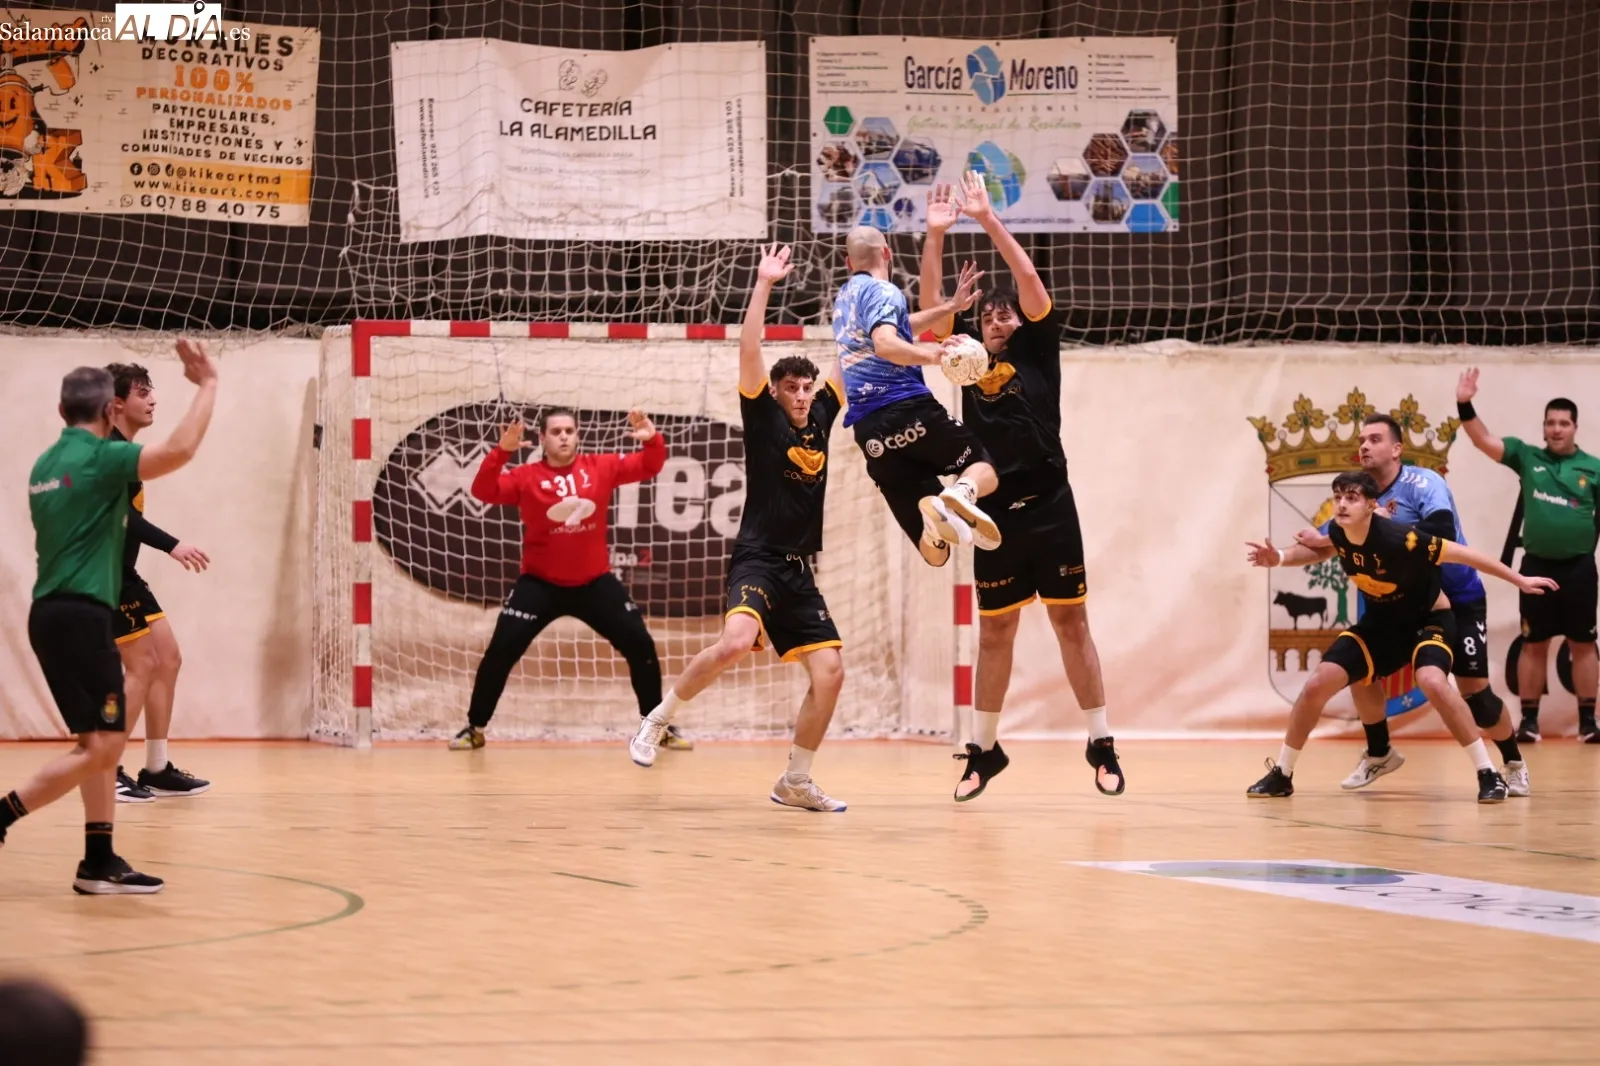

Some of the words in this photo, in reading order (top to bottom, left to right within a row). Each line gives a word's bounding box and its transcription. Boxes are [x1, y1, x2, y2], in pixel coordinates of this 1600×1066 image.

[142, 47, 284, 72] DECORATIVOS
[174, 64, 254, 94] 100%
[904, 55, 963, 90] García
[1008, 58, 1079, 91] Moreno
[136, 86, 293, 111] PERSONALIZADOS
[520, 95, 632, 117] CAFETERÍA
[152, 103, 276, 126] PARTICULARES,
[169, 118, 256, 138] EMPRESAS,
[499, 120, 523, 137] LA
[530, 123, 657, 142] ALAMEDILLA
[142, 129, 264, 150] INSTITUCIONES
[274, 140, 283, 151] Y
[121, 143, 212, 159] COMUNIDADES
[219, 151, 236, 161] DE
[243, 153, 303, 166] VECINOS
[217, 202, 245, 217] 40
[255, 205, 280, 219] 75
[884, 421, 927, 450] ceos
[553, 473, 578, 497] 31
[1352, 552, 1365, 567] 67
[1463, 636, 1477, 656] 8
